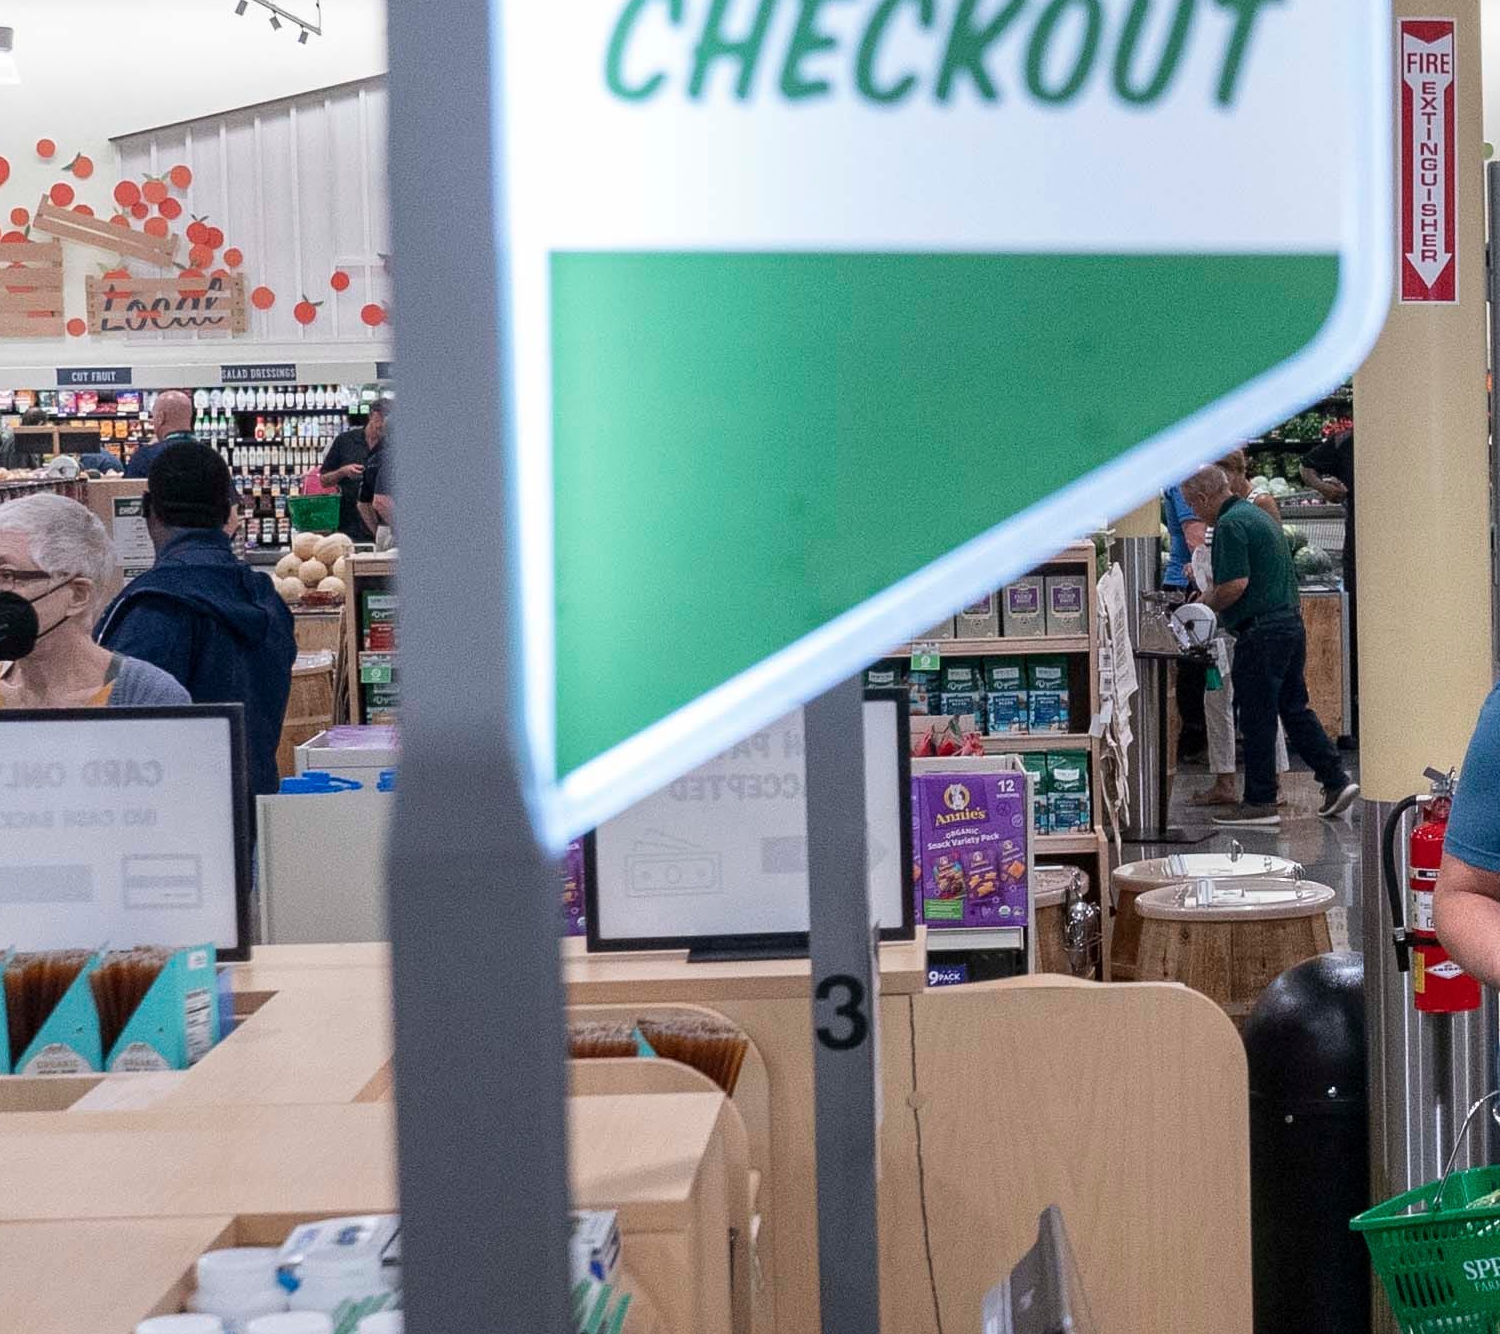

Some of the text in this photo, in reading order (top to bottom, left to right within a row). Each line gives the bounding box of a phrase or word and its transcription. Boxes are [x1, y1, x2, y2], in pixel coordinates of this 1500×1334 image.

[1406, 53, 1451, 75] FIRE
[1420, 81, 1438, 263] EXTINGUISHER
[100, 275, 227, 333] Local
[71, 371, 116, 383] CUT FRUIT
[222, 366, 297, 380] SALAD DRESSINGS
[996, 779, 1016, 793] 12
[933, 808, 987, 828] Annie's
[928, 832, 1000, 850] Snack Variety Pack
[945, 827, 980, 838] ORGANIC
[814, 974, 870, 1052] 3
